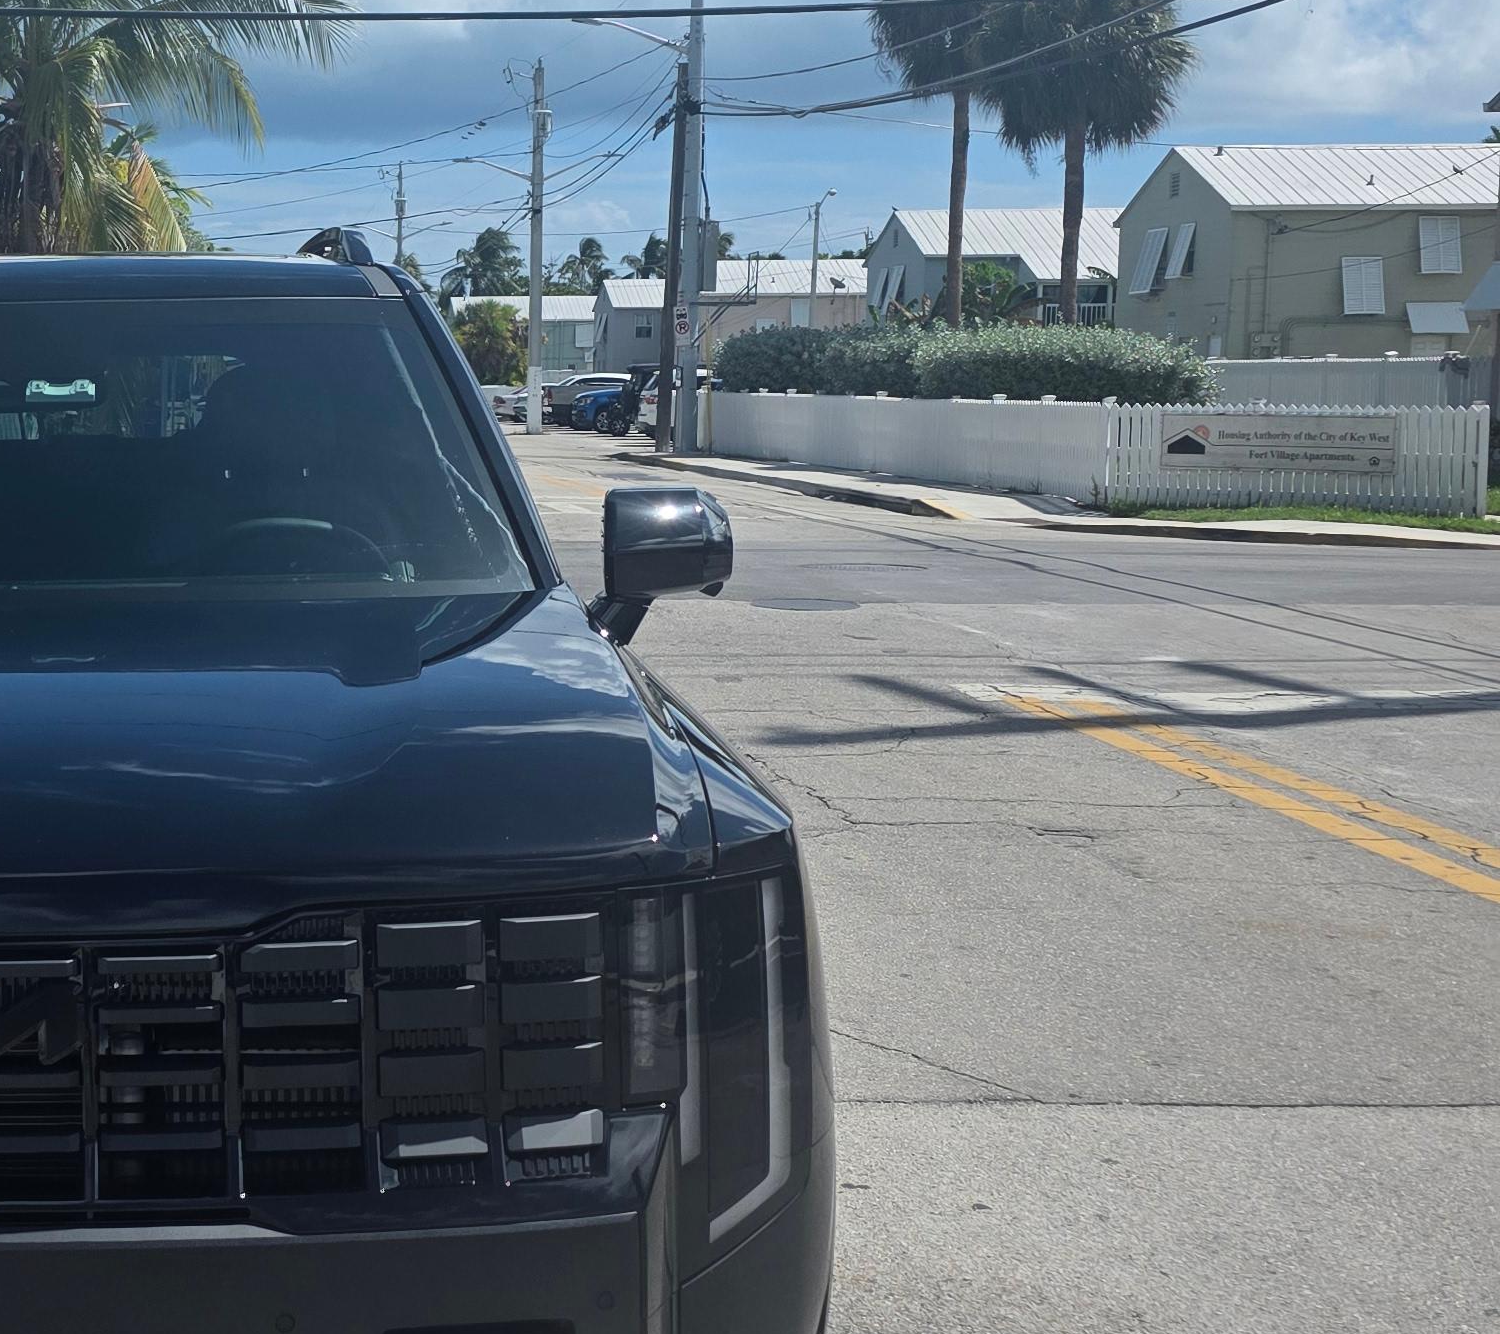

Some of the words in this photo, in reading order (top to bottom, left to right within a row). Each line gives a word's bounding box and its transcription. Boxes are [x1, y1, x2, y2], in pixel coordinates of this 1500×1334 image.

[1218, 430, 1251, 441] Housing
[1254, 431, 1291, 442] Authority
[1293, 431, 1303, 440] of
[1304, 432, 1317, 441] the
[1319, 432, 1336, 443] City
[1338, 432, 1348, 442] of
[1349, 432, 1366, 444] Key
[1368, 433, 1390, 443] West
[1249, 449, 1267, 459] Fort
[1269, 450, 1300, 461] Village
[1303, 451, 1355, 463] Apartments
